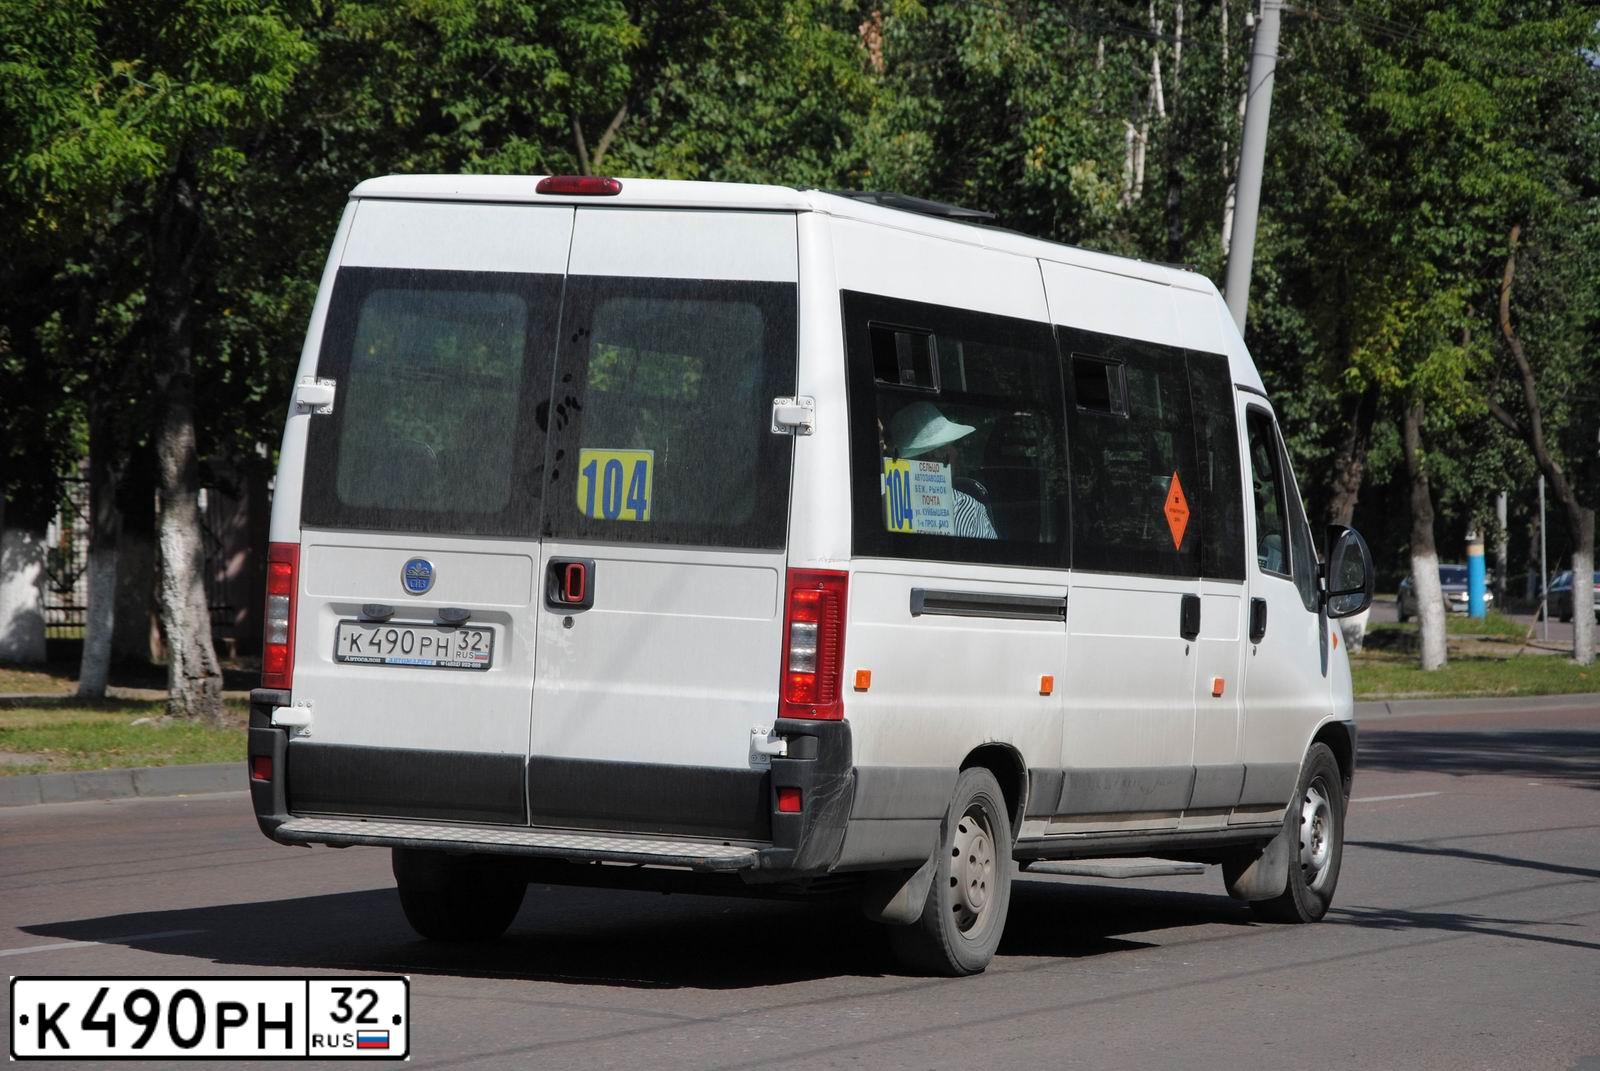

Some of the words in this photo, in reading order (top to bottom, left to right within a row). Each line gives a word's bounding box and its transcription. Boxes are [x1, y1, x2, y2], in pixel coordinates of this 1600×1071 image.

[919, 462, 940, 474] СЕЛЬЦО
[582, 458, 648, 521] 104
[928, 486, 946, 495] РЫНОК
[885, 468, 913, 530] 104
[922, 495, 940, 506] ПОЧТА
[458, 630, 483, 651] 32
[456, 651, 474, 660] RUS
